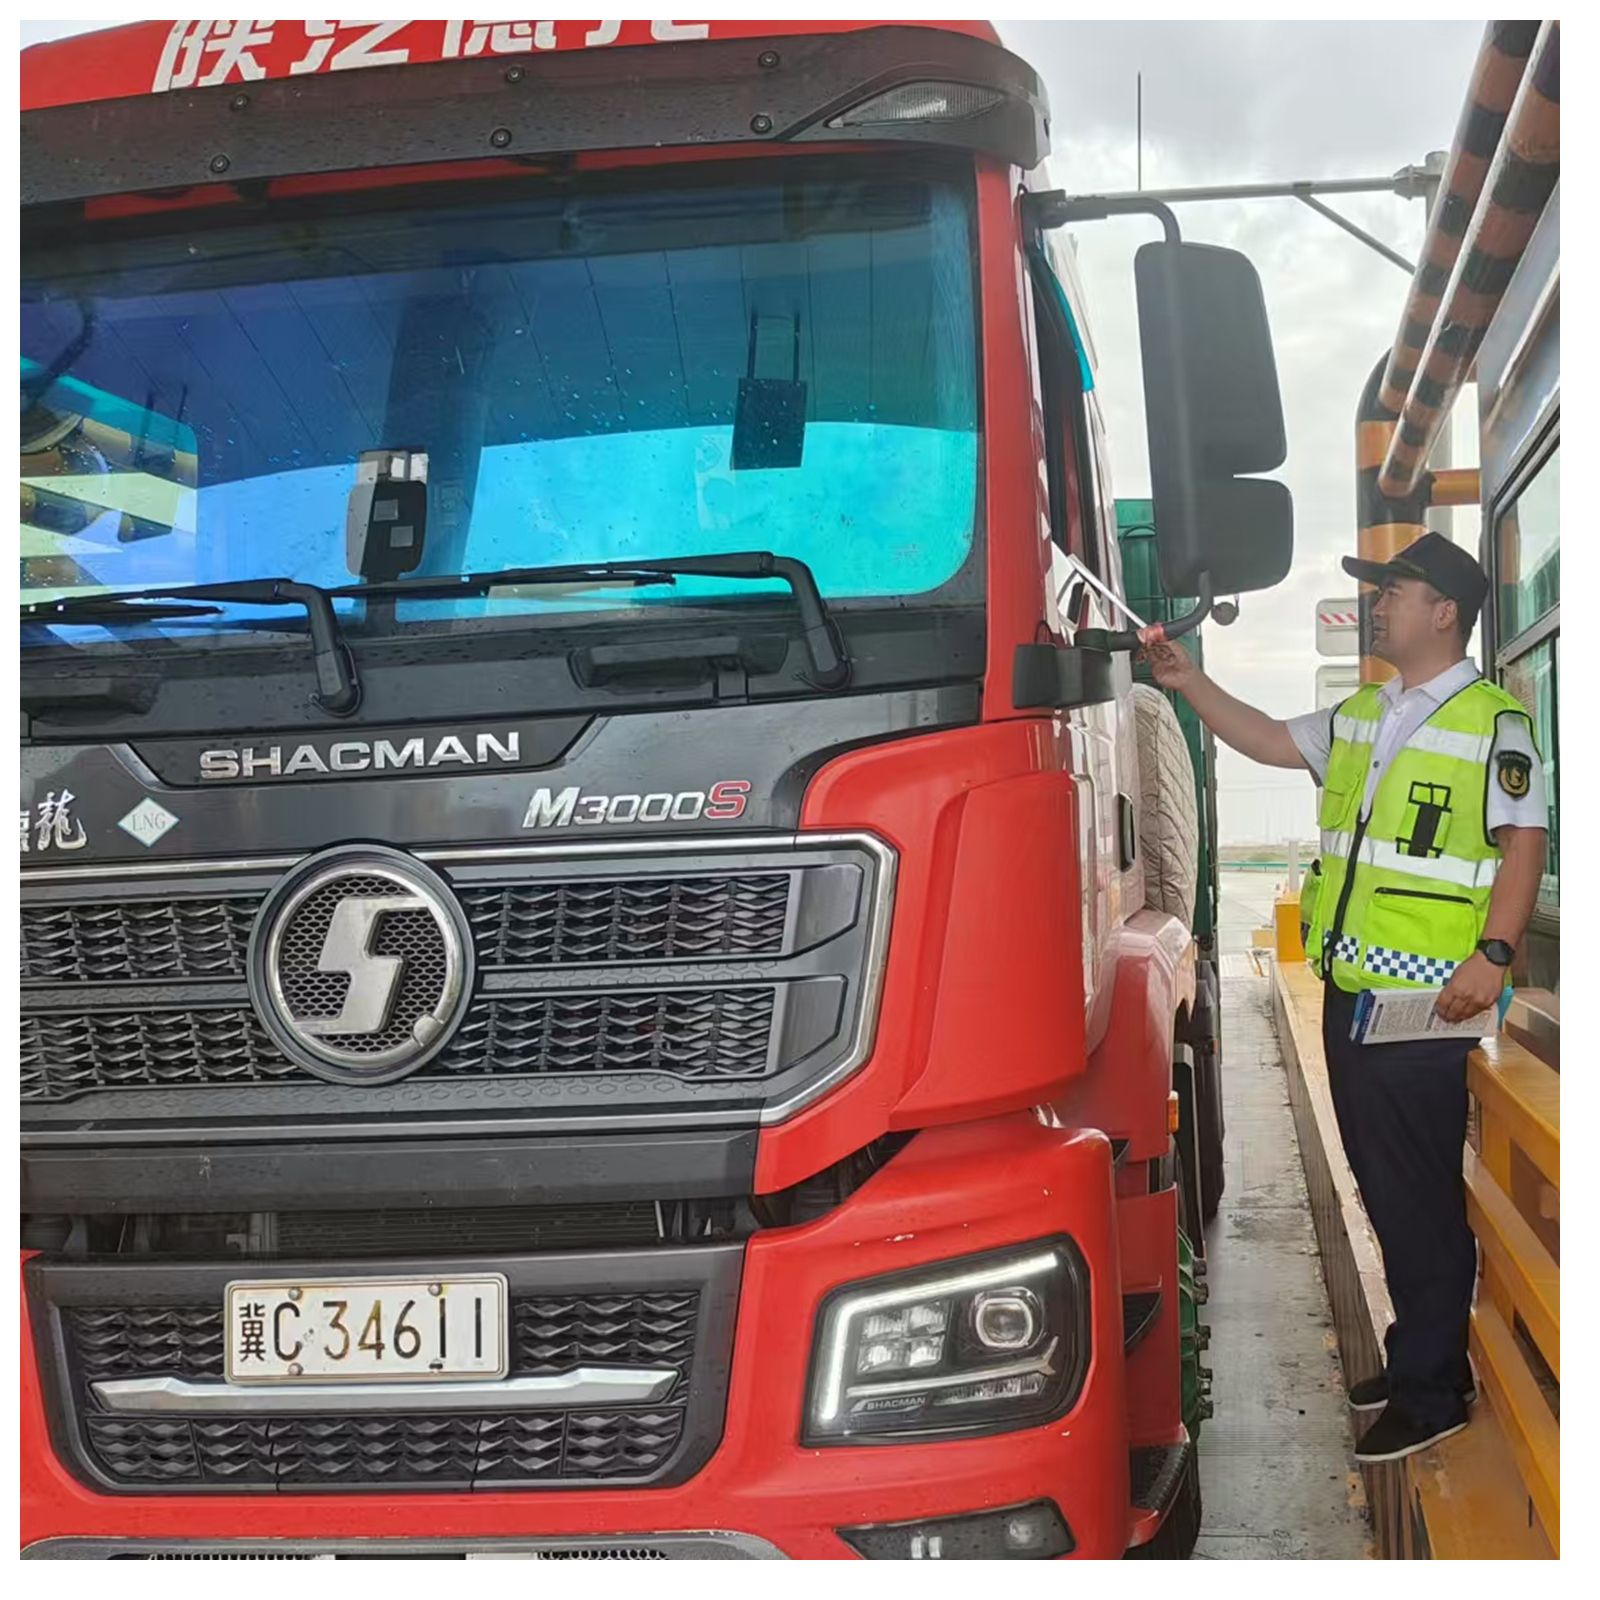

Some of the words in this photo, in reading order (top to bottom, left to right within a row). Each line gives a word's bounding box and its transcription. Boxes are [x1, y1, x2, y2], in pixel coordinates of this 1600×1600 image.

[200, 731, 520, 780] SHACMAN
[131, 813, 166, 832] LNG
[522, 780, 752, 829] M3000S
